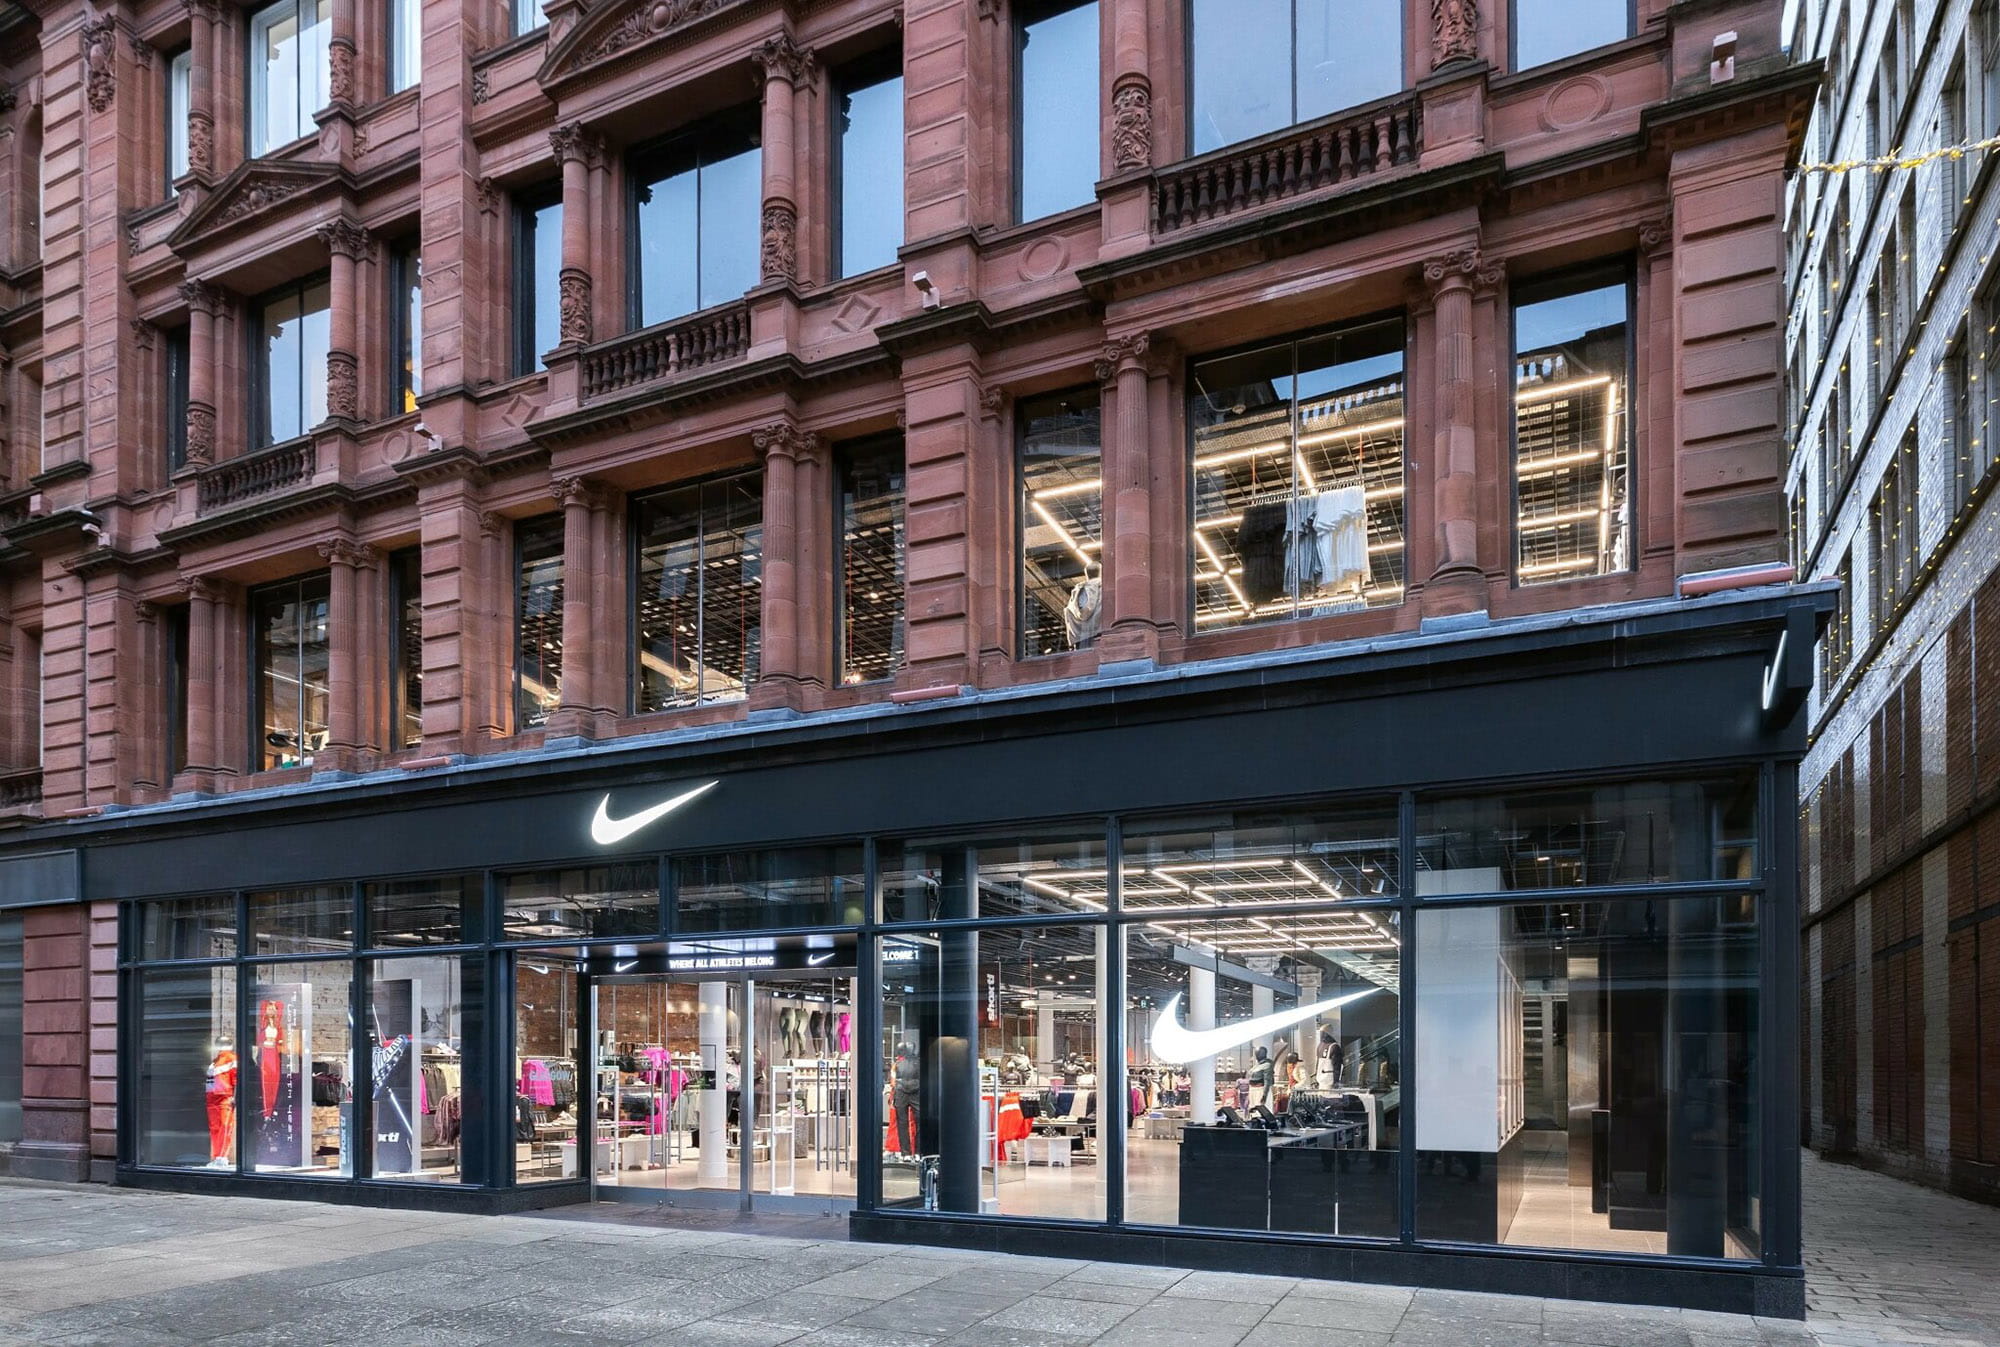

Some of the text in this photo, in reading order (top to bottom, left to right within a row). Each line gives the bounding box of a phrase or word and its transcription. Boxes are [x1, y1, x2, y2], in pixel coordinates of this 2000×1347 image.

[882, 950, 914, 960] ELCOME
[669, 956, 775, 969] WHERE ALL ATHLETES BELONG
